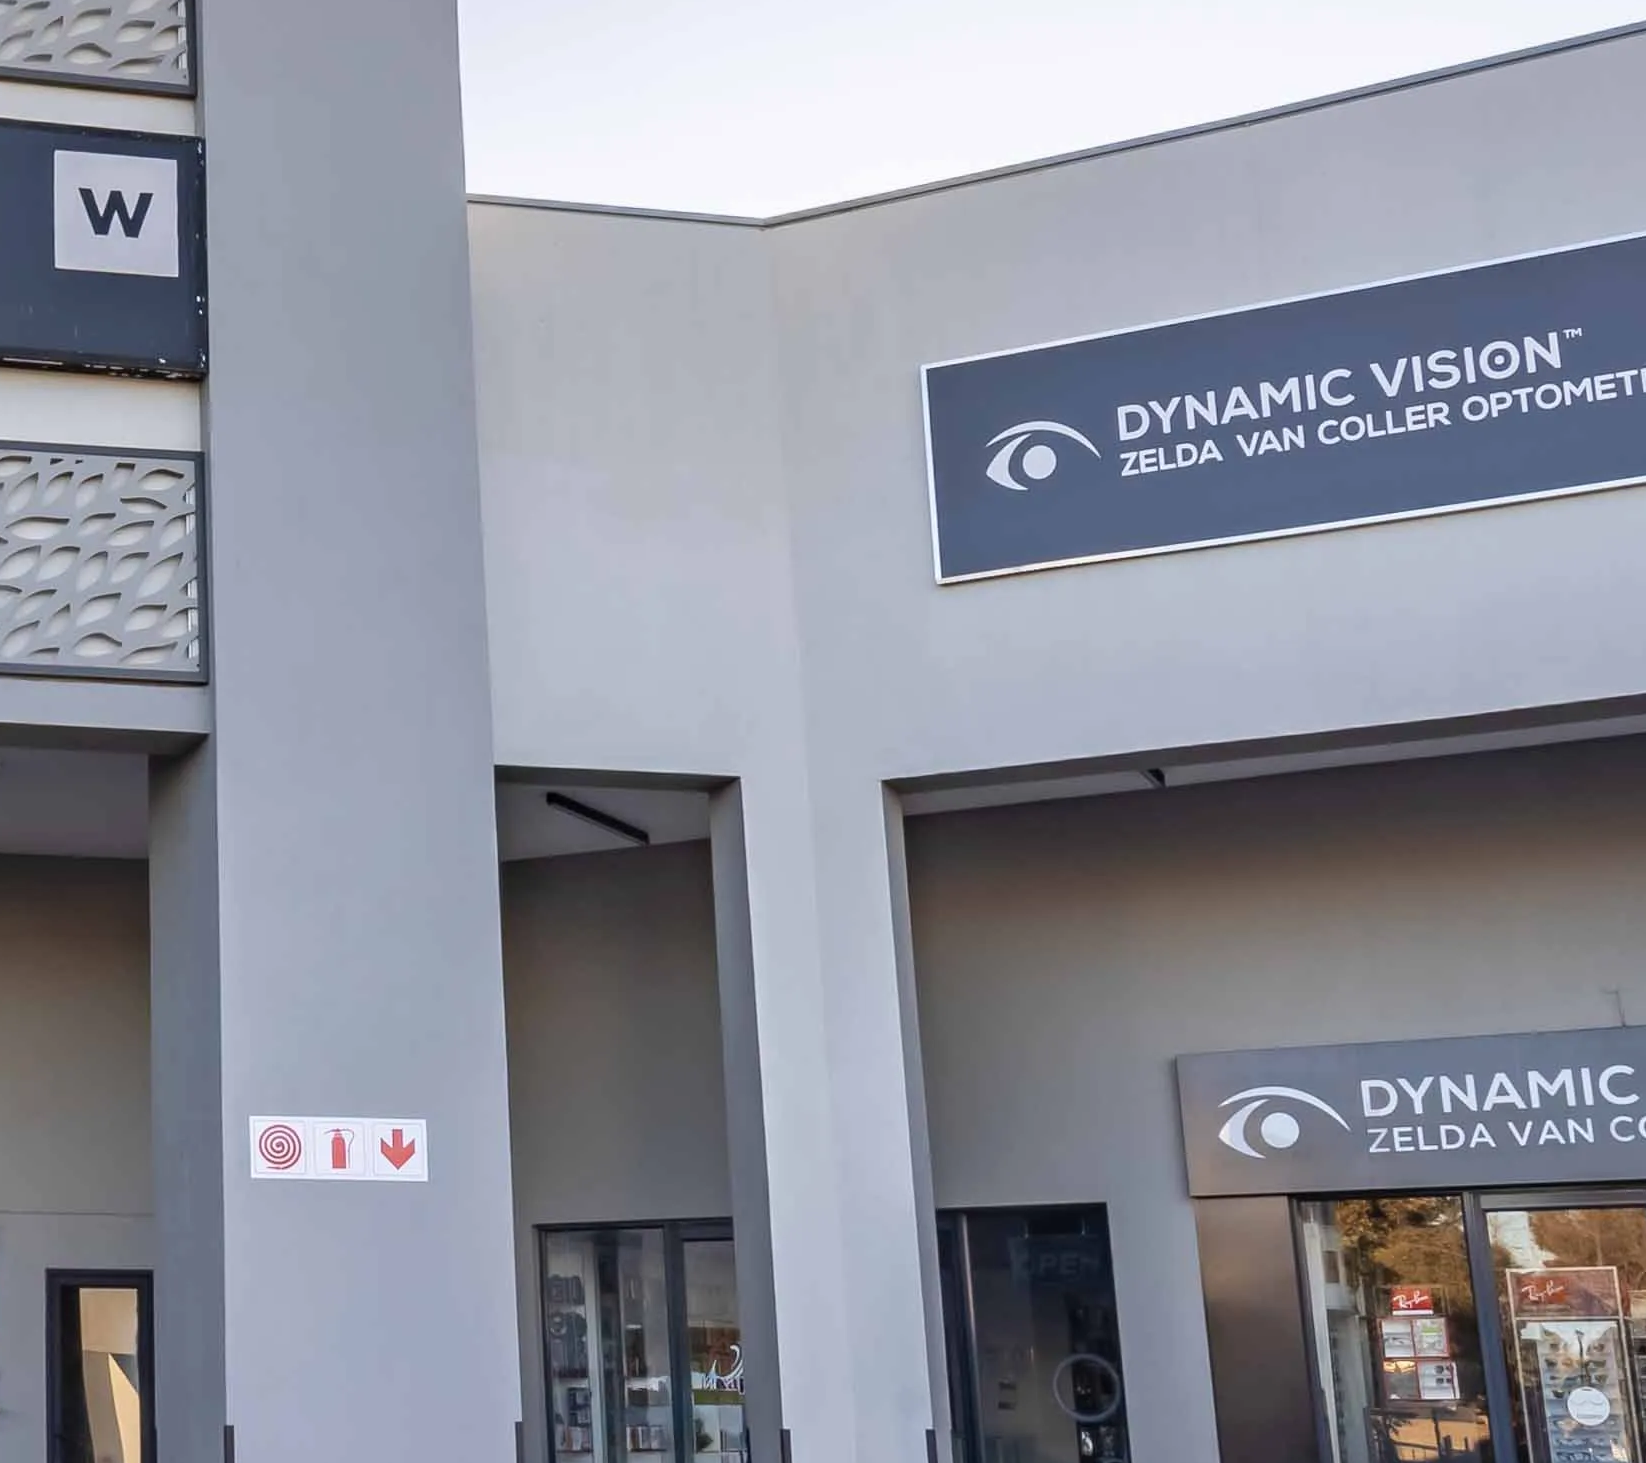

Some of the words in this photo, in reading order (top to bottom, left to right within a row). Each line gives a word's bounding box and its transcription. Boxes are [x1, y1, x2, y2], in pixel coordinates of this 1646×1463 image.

[78, 187, 154, 239] W
[1117, 368, 1355, 441] DYNAMIC
[1120, 440, 1224, 477] ZELDA
[1236, 425, 1306, 457] VAN
[1317, 402, 1452, 445] COLLER
[1361, 1064, 1640, 1118] DYNAMIC
[1367, 1123, 1497, 1153] ZELDA
[1507, 1118, 1595, 1147] VAN
